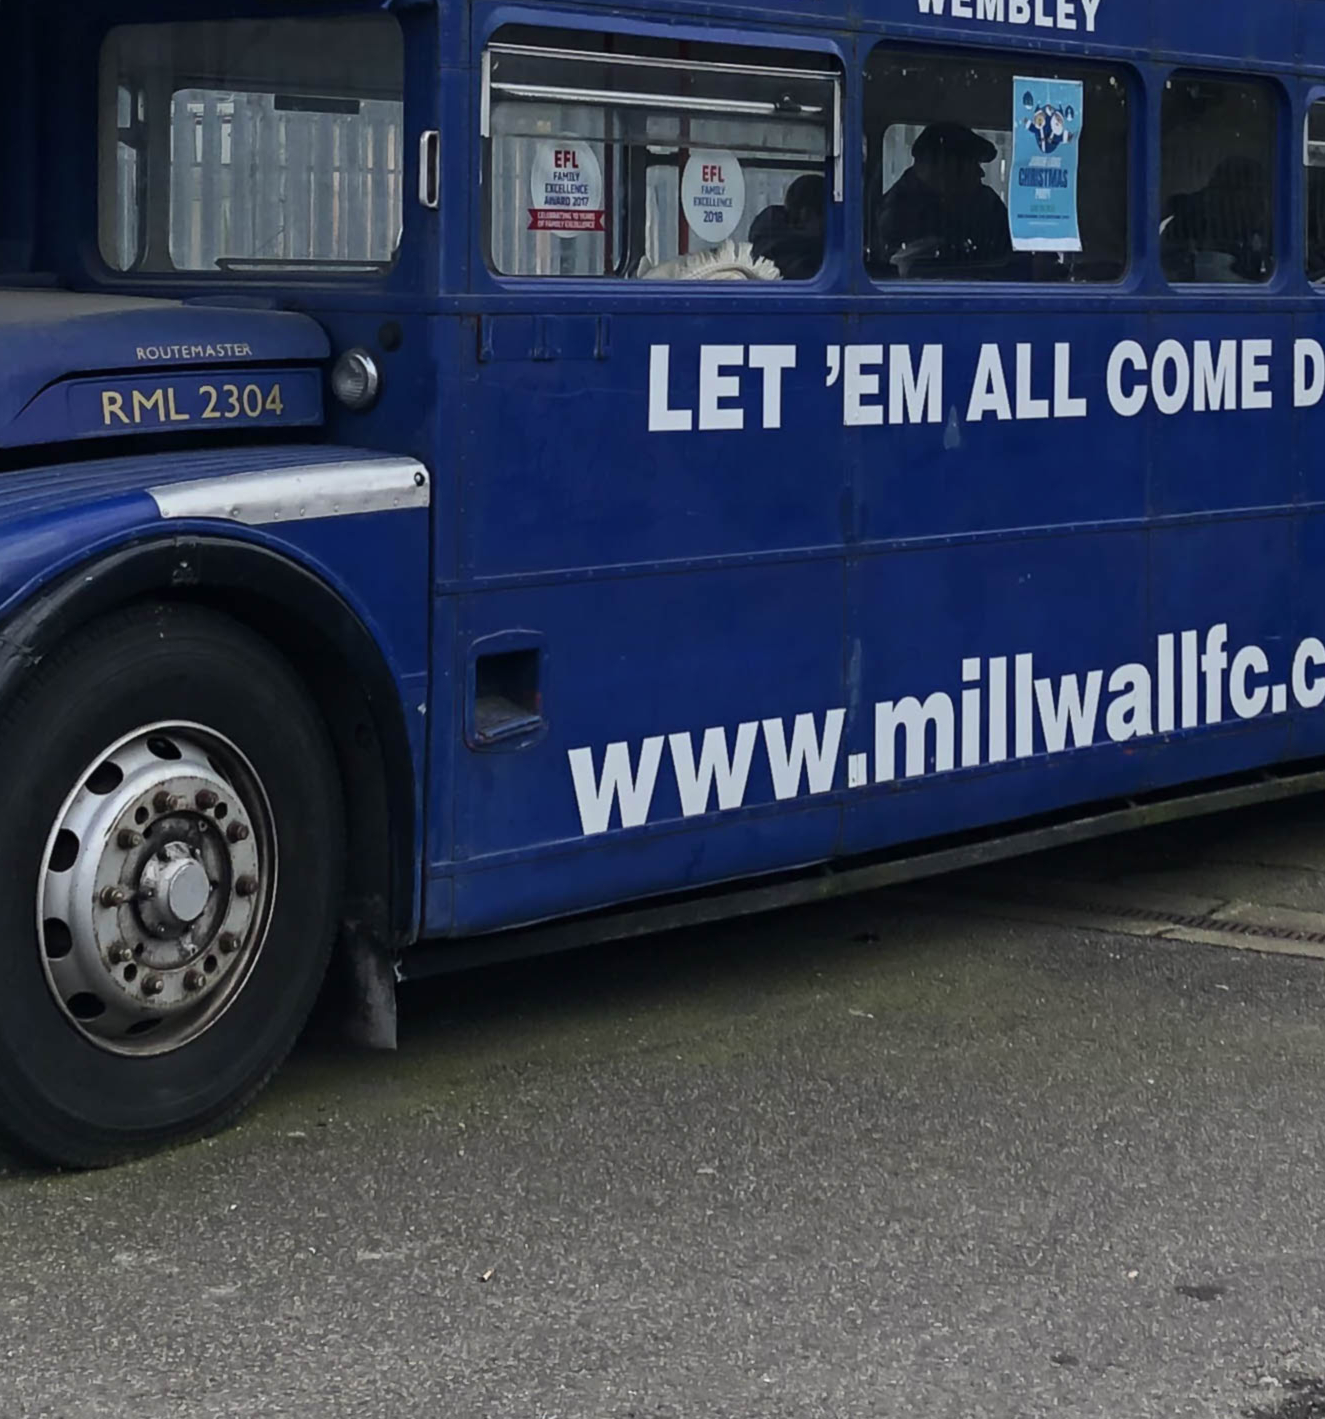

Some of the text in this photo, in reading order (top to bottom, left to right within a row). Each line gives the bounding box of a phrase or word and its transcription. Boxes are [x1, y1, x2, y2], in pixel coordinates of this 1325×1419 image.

[554, 150, 579, 168] EFL
[553, 172, 580, 181] FAMILY
[702, 165, 725, 182] EFL
[1018, 168, 1068, 188] CHRISTMAS
[545, 183, 588, 194] EXCELLENCE
[701, 185, 725, 195] FAMILY
[544, 196, 570, 206] AWARD
[693, 197, 732, 207] EXCELLENCE
[136, 343, 252, 360] ROUTEMASTER
[648, 344, 796, 431] LET
[825, 344, 942, 426] 'EM
[966, 342, 1086, 421] ALL
[1106, 339, 1272, 417] COME
[101, 384, 283, 425] RML 2304
